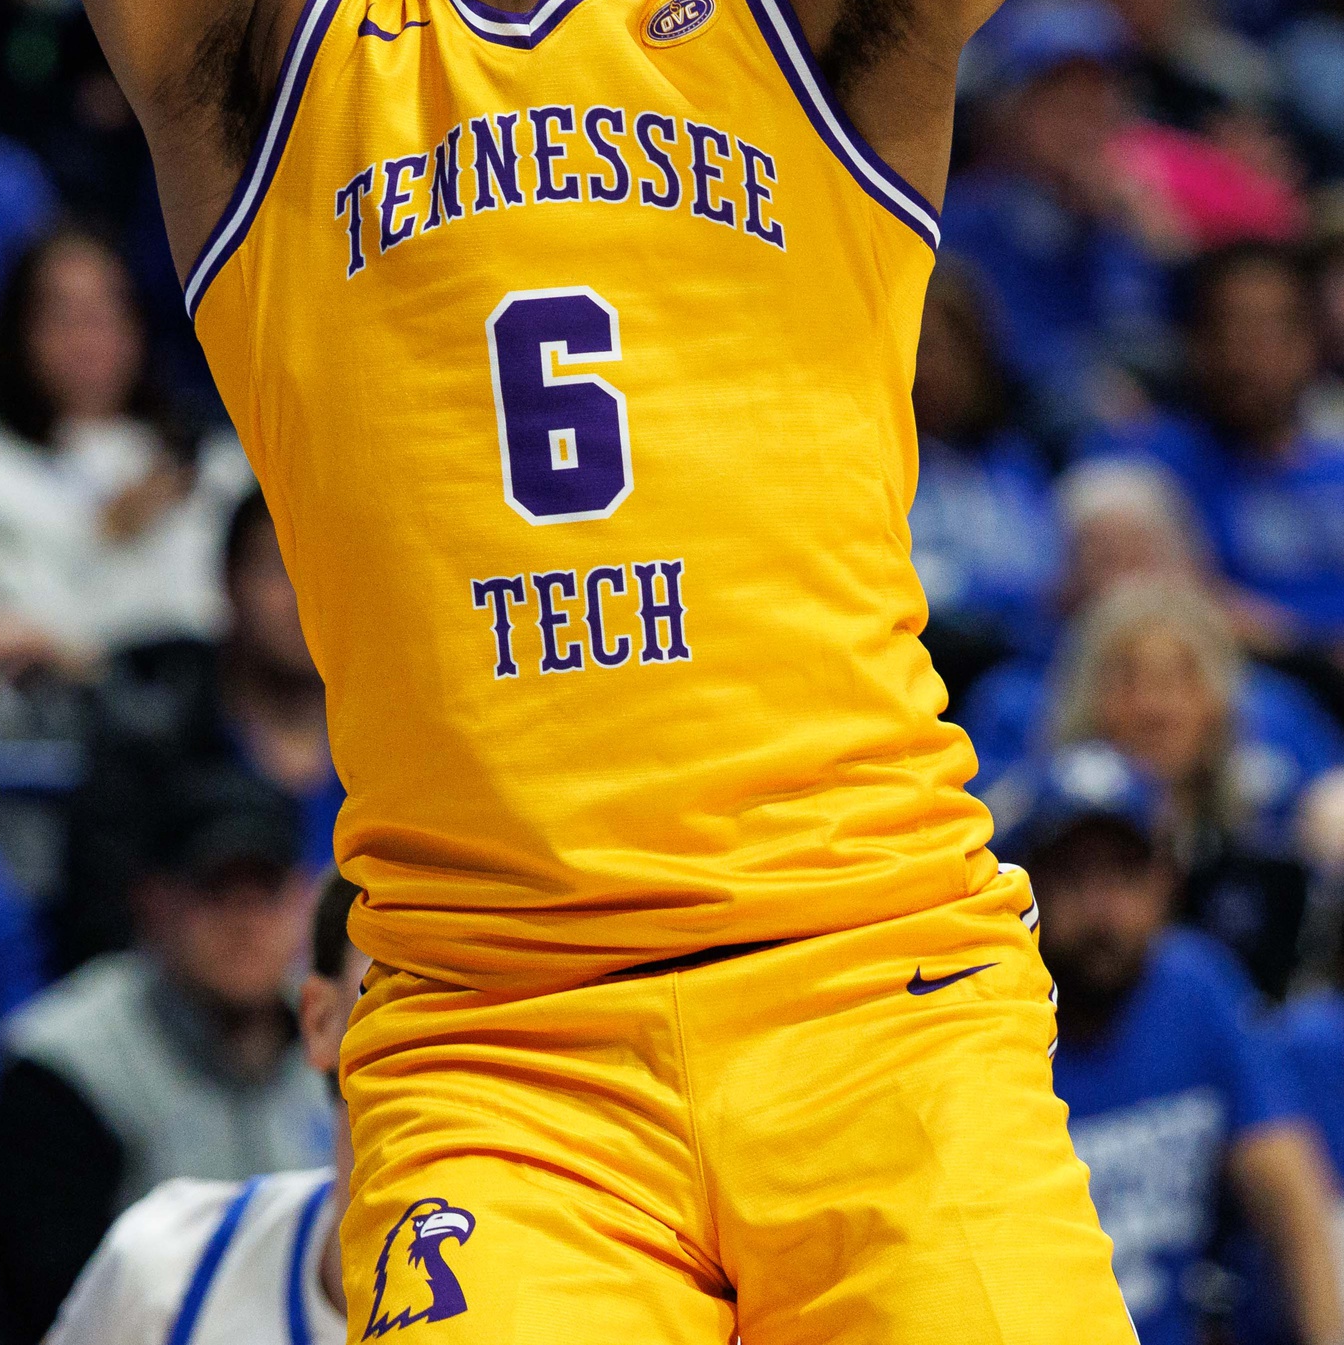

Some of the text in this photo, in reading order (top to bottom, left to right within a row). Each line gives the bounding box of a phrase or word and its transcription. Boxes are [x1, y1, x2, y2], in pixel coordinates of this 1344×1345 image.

[660, 1, 699, 33] OVC
[334, 104, 787, 281] TENNESSEE
[485, 285, 635, 526] 6
[470, 557, 693, 680] TECH
